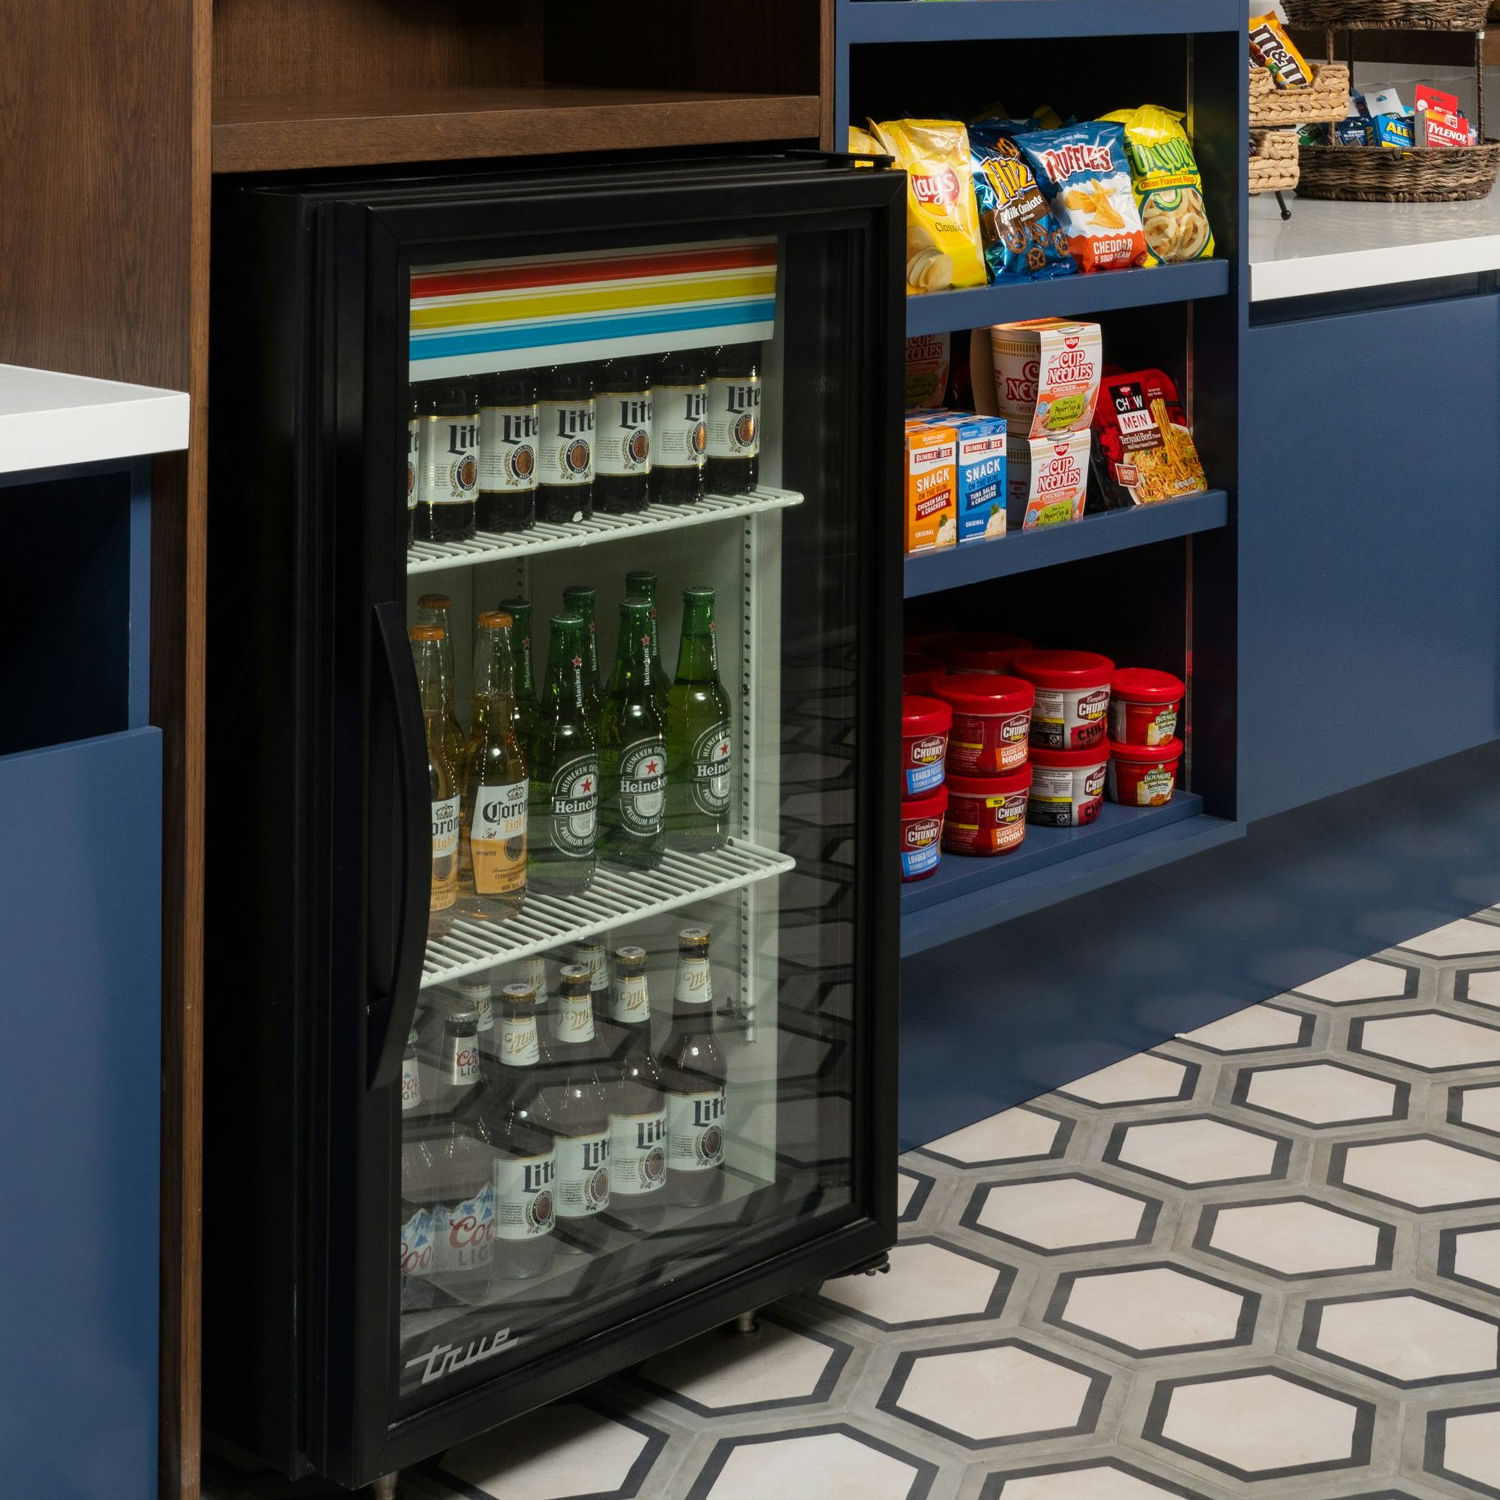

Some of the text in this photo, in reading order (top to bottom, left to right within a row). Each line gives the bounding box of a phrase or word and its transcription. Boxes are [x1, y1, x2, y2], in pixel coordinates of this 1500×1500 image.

[1428, 122, 1467, 144] TYLENOL
[1043, 144, 1113, 183] RUFFLES
[1141, 177, 1183, 189] Onion Flavored
[935, 222, 964, 232] Classic
[1094, 238, 1133, 255] CHEDDAR
[1100, 254, 1113, 262] SOUR
[1059, 350, 1085, 367] CUP
[1047, 363, 1093, 386] NOODLES
[1053, 385, 1075, 393] CHICKEN
[725, 385, 761, 415] Lite
[1115, 395, 1143, 412] CHOW
[501, 414, 539, 445] Lite
[556, 408, 595, 439] Lite
[1123, 414, 1147, 429] MEIN
[965, 439, 1001, 453] BUMBLE BEE
[1119, 432, 1152, 445] Teriyaki Beef
[916, 448, 951, 462] BUMBLE BEE
[966, 459, 1000, 482] SNACK
[1049, 456, 1074, 473] CUP
[917, 468, 950, 492] SNACK
[1037, 469, 1080, 493] NOODLES
[970, 484, 997, 500] TUNA SALAD
[975, 491, 997, 505] CRACKERS
[918, 492, 949, 511] CHICKEN SALAD
[925, 500, 946, 514] CRACKERS
[915, 529, 934, 538] ORIGINAL
[1003, 723, 1029, 737] CHUNKY
[626, 747, 653, 772] HEINEKEN
[913, 744, 943, 759] CHUNKY
[913, 770, 930, 782] LOADED
[626, 806, 648, 825] PREMIUM
[998, 804, 1025, 818] CHUNKY
[908, 827, 938, 842] CHUNKY
[405, 1327, 519, 1384] true
